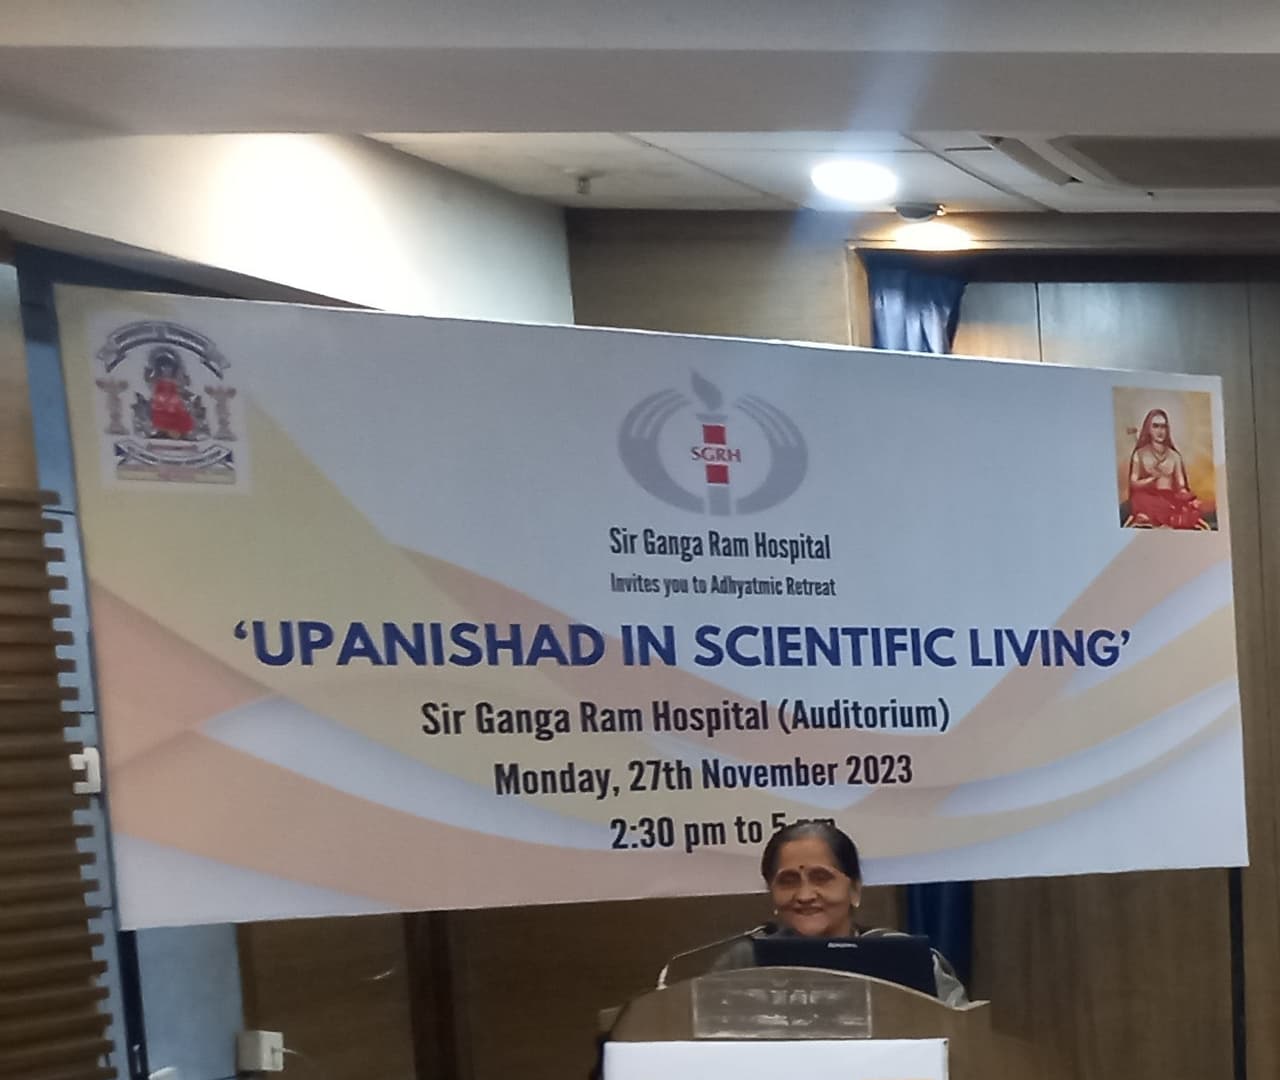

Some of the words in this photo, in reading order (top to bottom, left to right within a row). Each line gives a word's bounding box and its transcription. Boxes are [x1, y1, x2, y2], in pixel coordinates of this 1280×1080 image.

[691, 446, 742, 463] SGRH
[609, 527, 638, 554] Sir
[643, 528, 703, 562] Ganga
[708, 530, 749, 557] Ram
[754, 532, 831, 564] Hospital
[610, 572, 660, 593] Invites
[663, 577, 689, 598] you
[692, 575, 707, 593] to
[711, 575, 783, 599] Adhyatmic
[785, 577, 837, 596] Retreat
[233, 620, 606, 667] ‘UPANISHAD
[621, 625, 677, 667] IN
[693, 624, 957, 668] SCIENTIFIC
[969, 627, 1131, 667] LIVING’
[421, 702, 466, 735] Sir
[476, 701, 570, 741] Ganga
[580, 700, 643, 733] Ram
[652, 700, 769, 738] Hospital
[778, 698, 951, 735] (Auditorium)
[494, 762, 620, 799] Monday,
[629, 760, 692, 791] 27th
[701, 756, 839, 789] November
[846, 755, 913, 784] 2023
[610, 817, 674, 849] 2:30
[684, 822, 726, 853] pm
[734, 816, 763, 844] to
